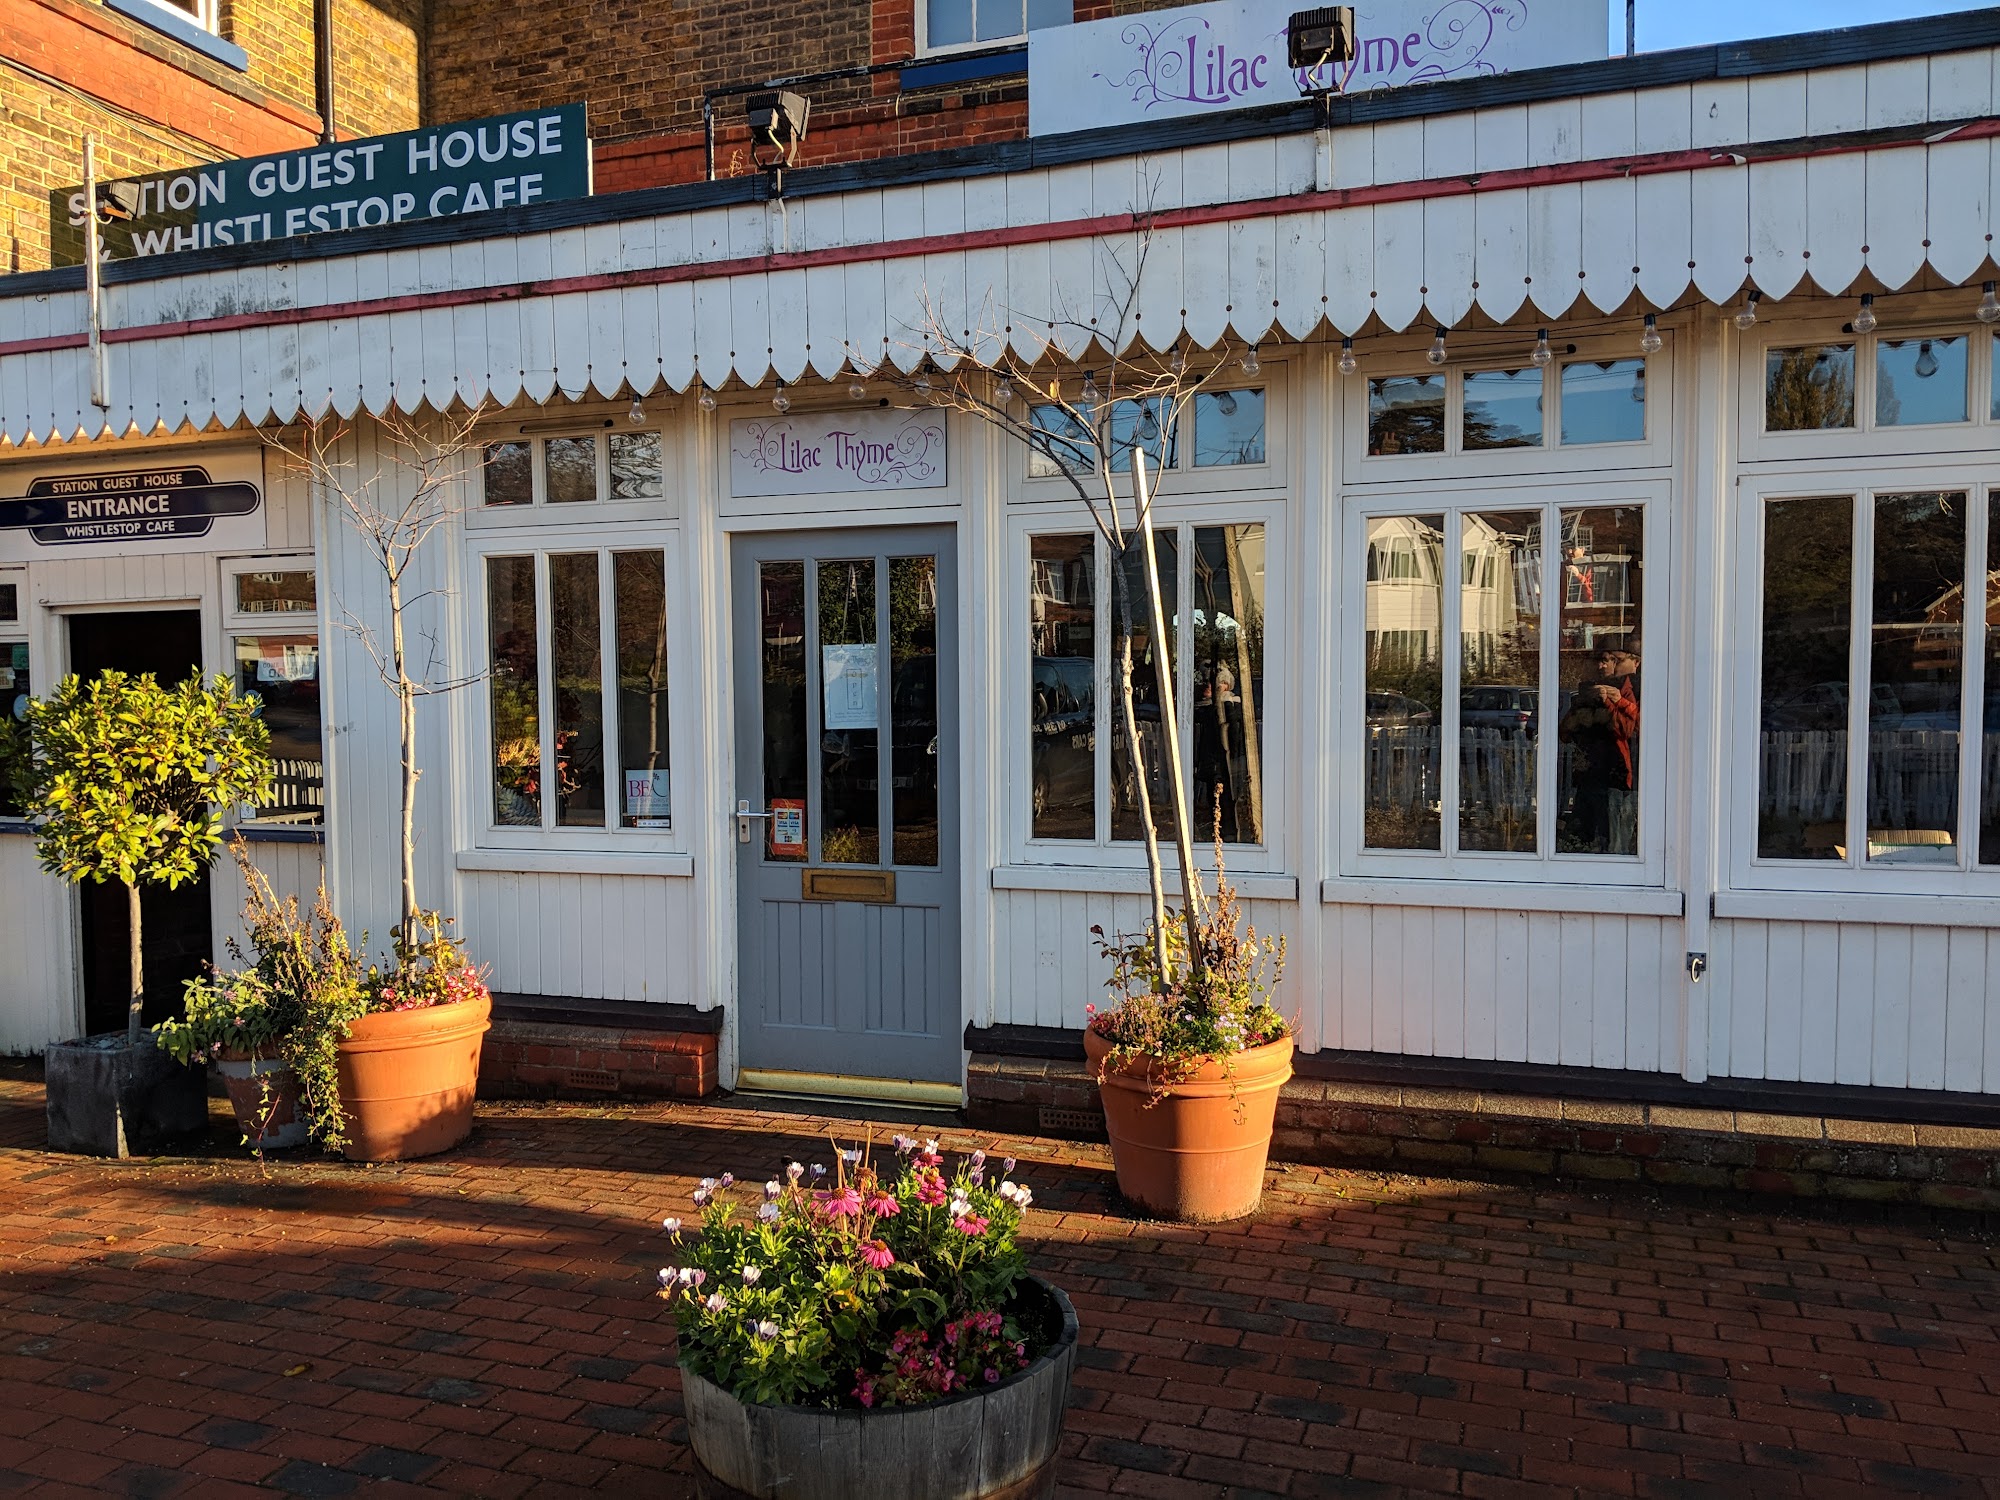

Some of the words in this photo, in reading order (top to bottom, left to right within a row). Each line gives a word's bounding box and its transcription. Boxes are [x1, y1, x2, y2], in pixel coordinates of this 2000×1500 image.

[1184, 34, 1268, 104] Lilac
[68, 170, 226, 226] STION
[248, 143, 384, 197] GUEST
[408, 115, 562, 174] HOUSE
[780, 432, 822, 473] Lilac
[825, 431, 896, 476] Thyme
[52, 479, 98, 494] STATION
[102, 476, 138, 490] GUEST
[144, 473, 183, 487] HOUSE
[67, 494, 170, 519] ENTRANCE
[65, 522, 141, 538] WHISTLESTOP
[146, 520, 175, 533] CAFE
